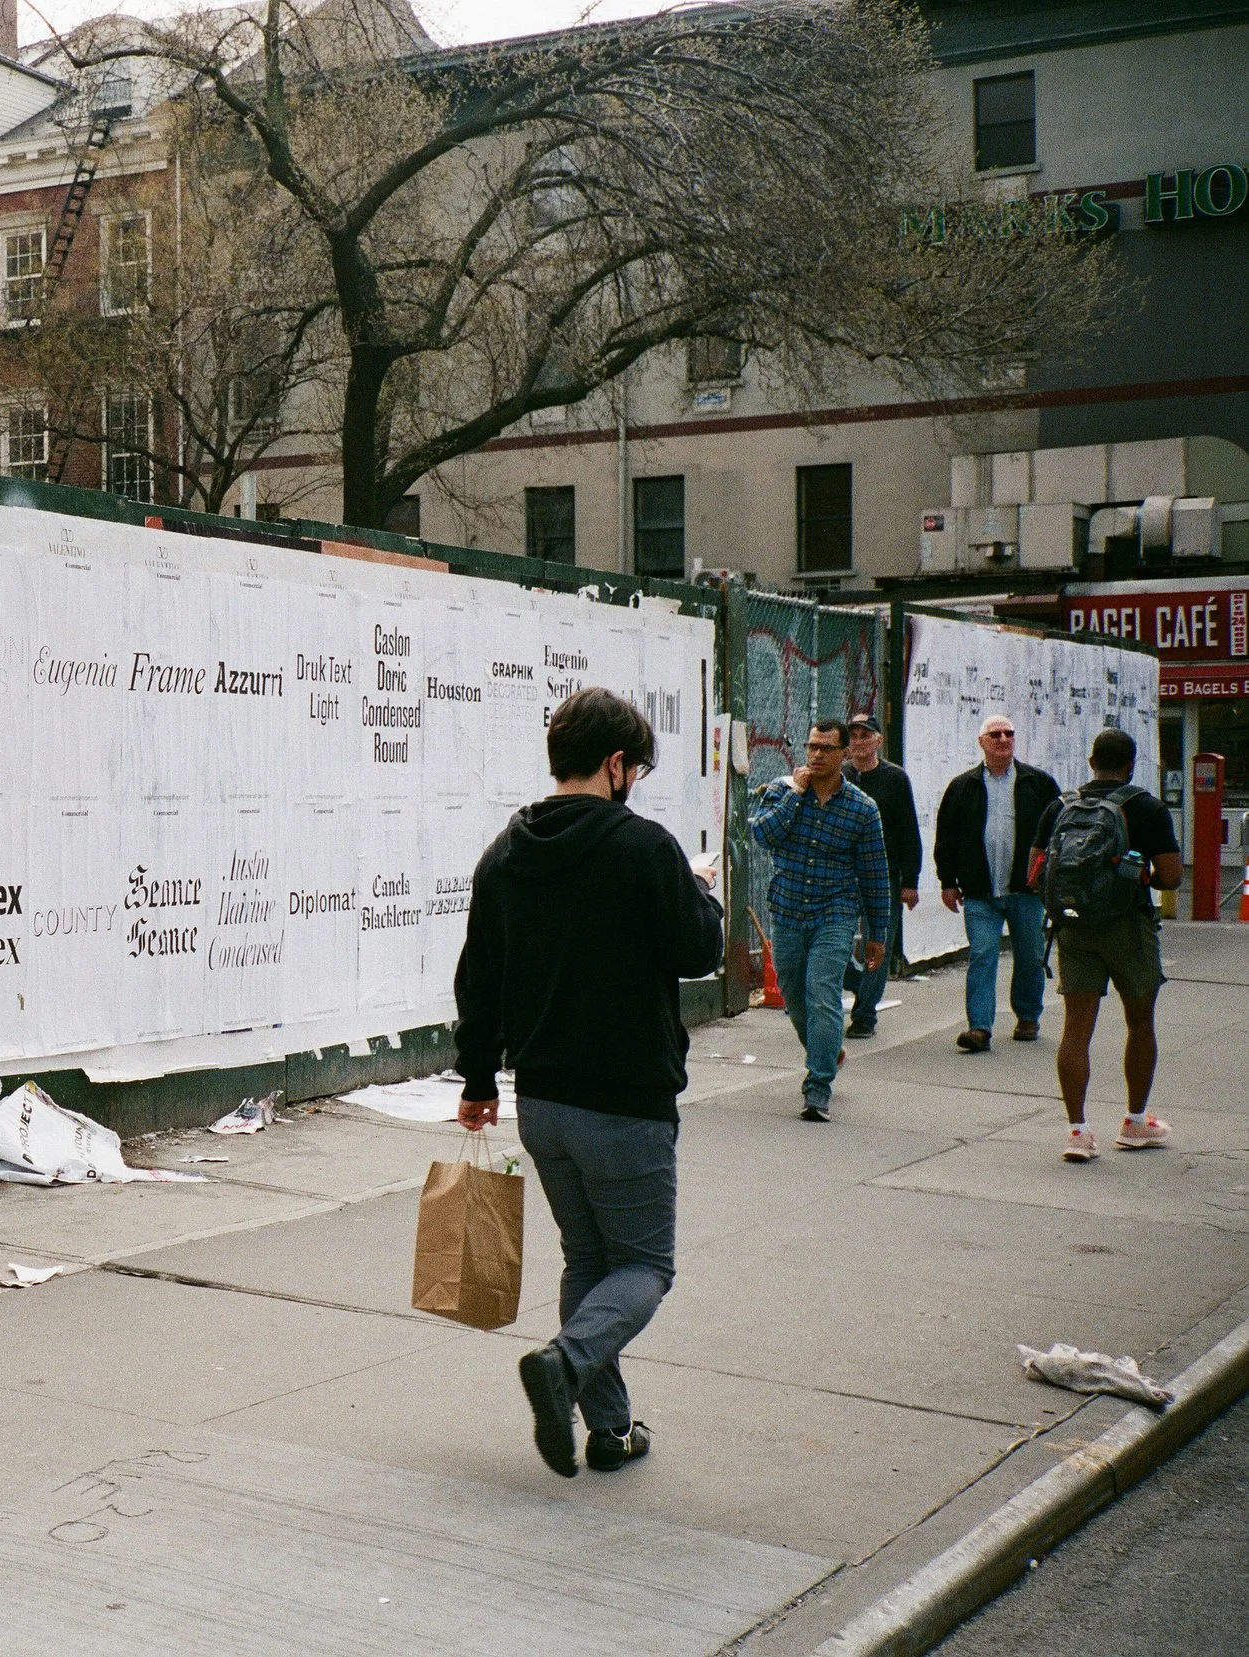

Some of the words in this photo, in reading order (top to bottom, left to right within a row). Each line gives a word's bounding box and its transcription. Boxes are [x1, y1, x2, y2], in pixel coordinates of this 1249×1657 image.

[1145, 162, 1249, 223] HO
[48, 542, 86, 558] VALENTINO
[1156, 596, 1218, 649] CAFÉ
[374, 623, 410, 657] Caslon
[32, 645, 118, 697] Eugenia
[128, 652, 206, 695] Frame
[296, 653, 326, 683] Druk
[328, 656, 351, 684] Text
[492, 661, 533, 680] GRAPHIK
[544, 644, 588, 673] Eugenio
[214, 661, 283, 698] Azzurri
[377, 660, 407, 693] Doric
[427, 676, 481, 703] Houston
[487, 680, 538, 702] DECORATED
[547, 676, 573, 699] Serif
[1160, 684, 1178, 695] ED
[310, 691, 339, 726] Light
[362, 696, 421, 729] Condensed
[374, 732, 408, 764] Round
[124, 864, 202, 910] Seance
[372, 872, 411, 898] Canela
[217, 889, 276, 926] Hairline
[289, 887, 356, 920] Diplomat
[361, 904, 422, 931] Blackletter
[426, 896, 471, 916] WESTE
[33, 904, 118, 937] COUNTY
[208, 929, 285, 971] Condensed
